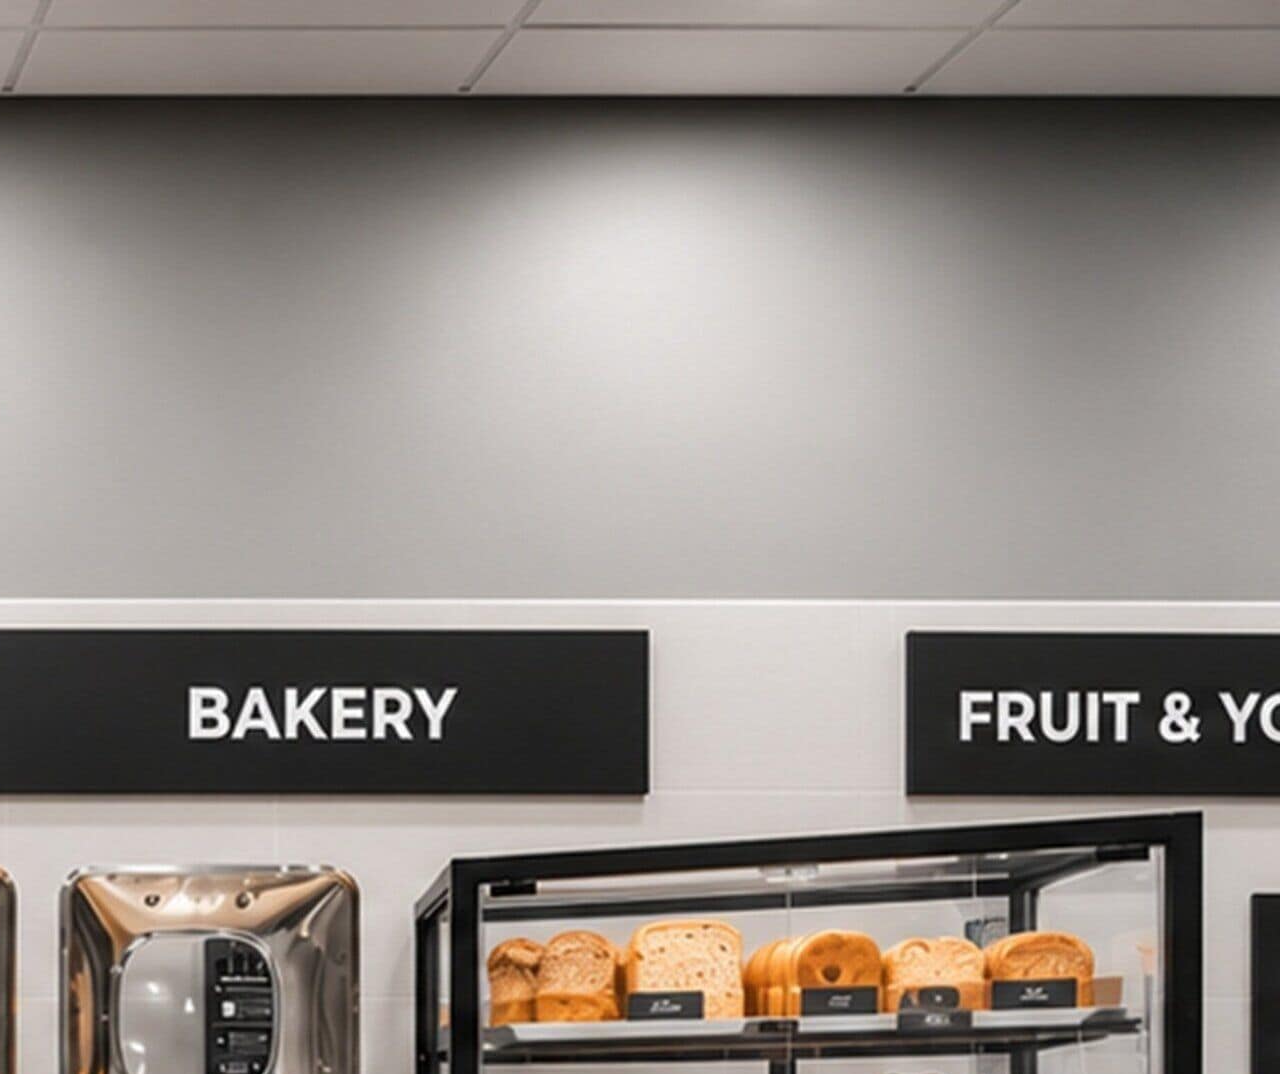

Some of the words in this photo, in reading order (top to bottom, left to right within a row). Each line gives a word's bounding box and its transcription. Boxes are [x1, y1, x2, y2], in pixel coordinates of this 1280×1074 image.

[188, 687, 458, 741] BAKERY
[958, 691, 1142, 743] FRUIT
[1158, 691, 1201, 743] &
